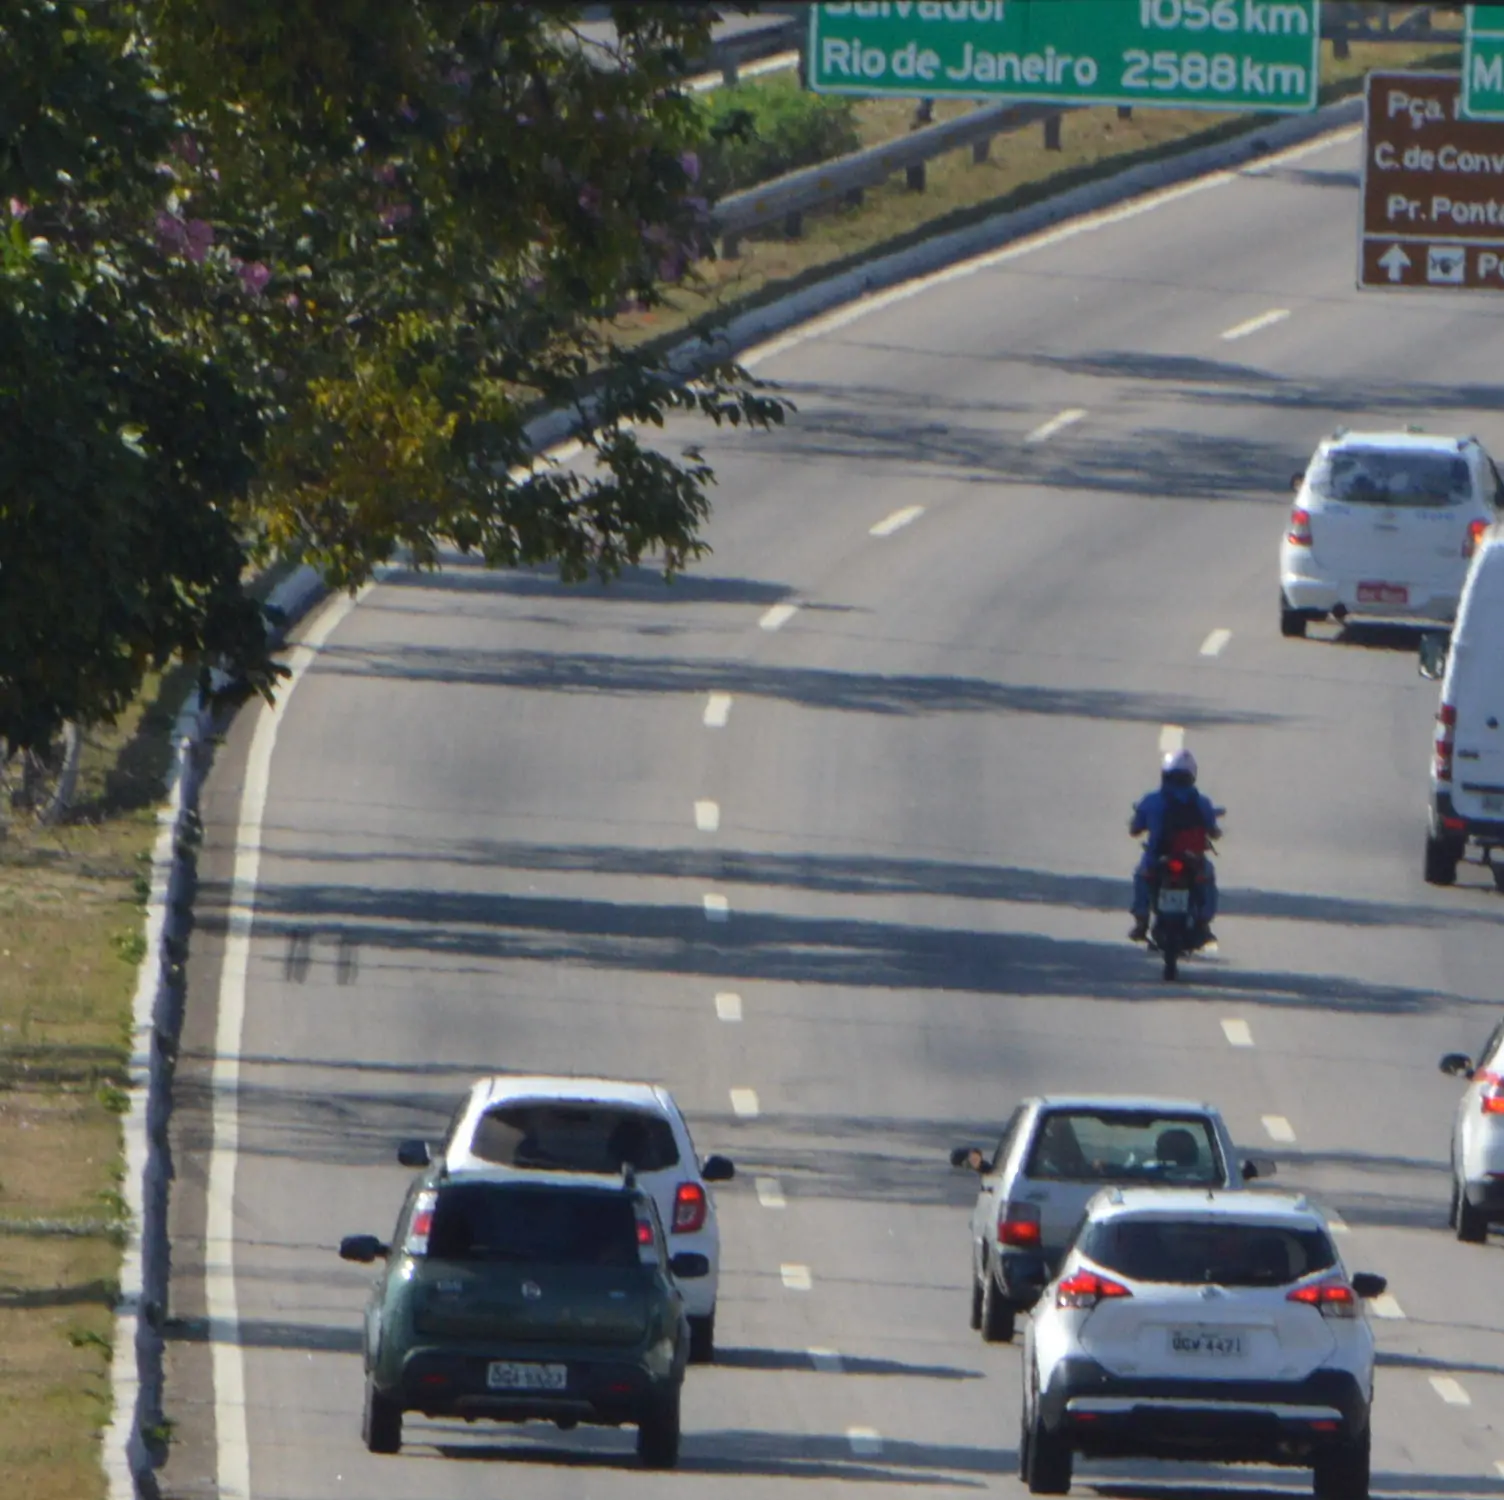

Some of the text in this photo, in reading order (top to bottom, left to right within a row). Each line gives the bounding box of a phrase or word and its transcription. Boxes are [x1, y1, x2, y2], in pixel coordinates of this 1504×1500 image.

[1245, 2, 1309, 34] km
[822, 37, 1306, 94] Rio de Janeiro 2588 km
[1386, 89, 1446, 130] Pça.
[1374, 141, 1399, 169] C.
[1402, 144, 1435, 171] de
[1386, 194, 1427, 222] Pr.
